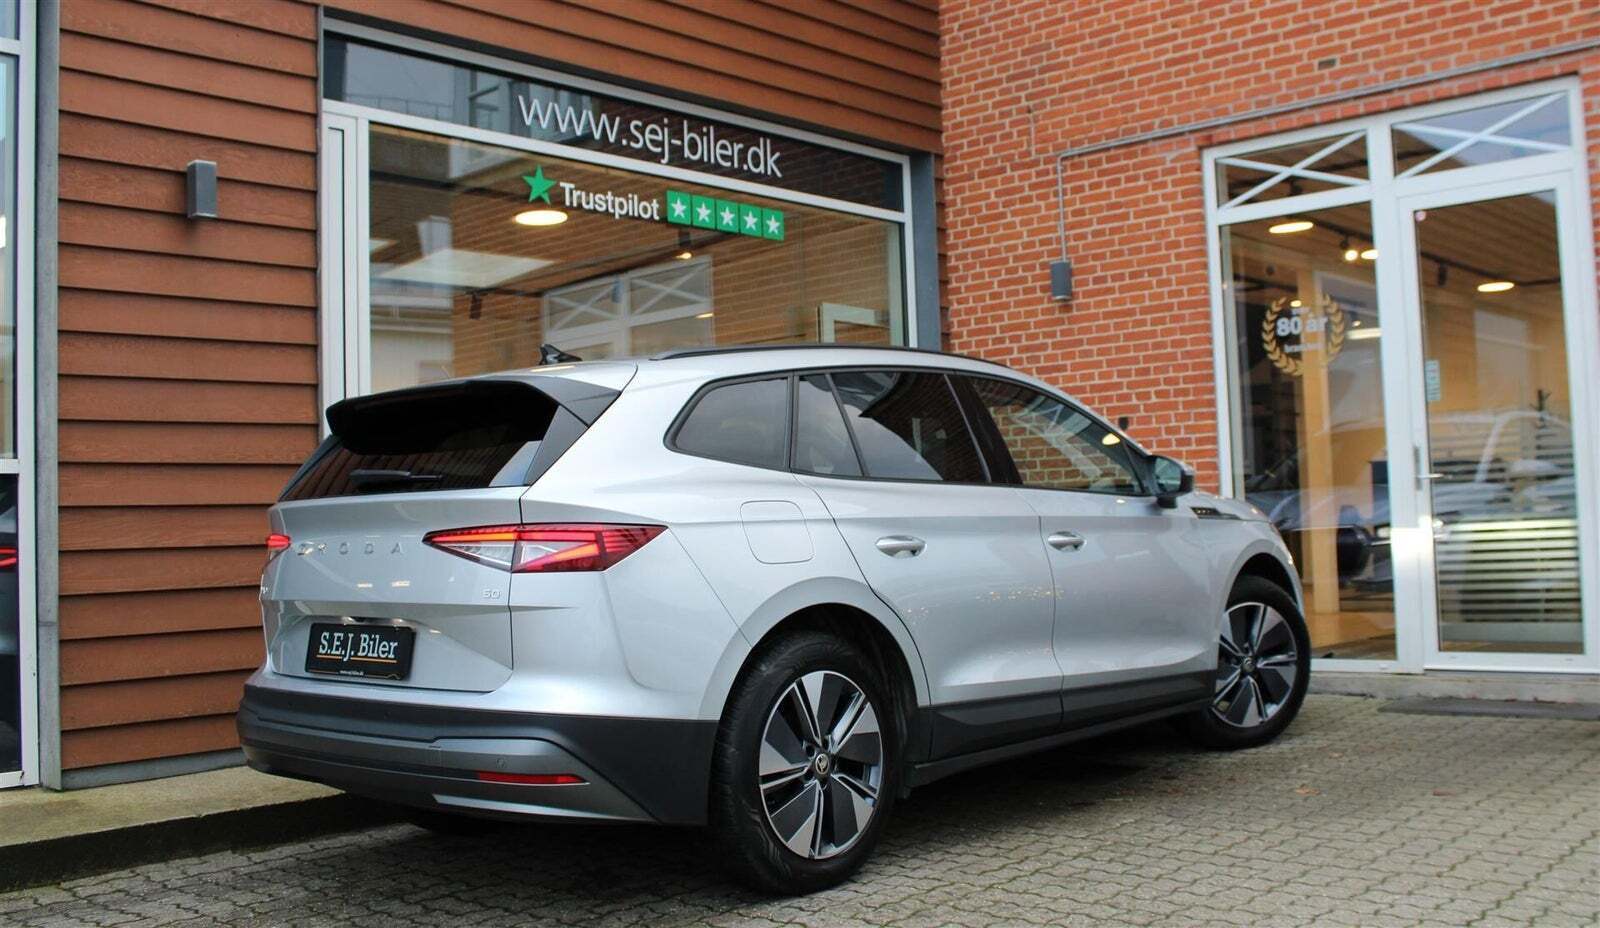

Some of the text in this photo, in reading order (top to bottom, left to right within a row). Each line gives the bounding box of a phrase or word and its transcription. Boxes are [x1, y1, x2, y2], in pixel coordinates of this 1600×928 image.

[518, 94, 782, 178] www.sej-biler.dk
[559, 181, 661, 221] Trustpilot
[1276, 316, 1302, 337] 80
[319, 631, 398, 662] S.E.J. Biler
